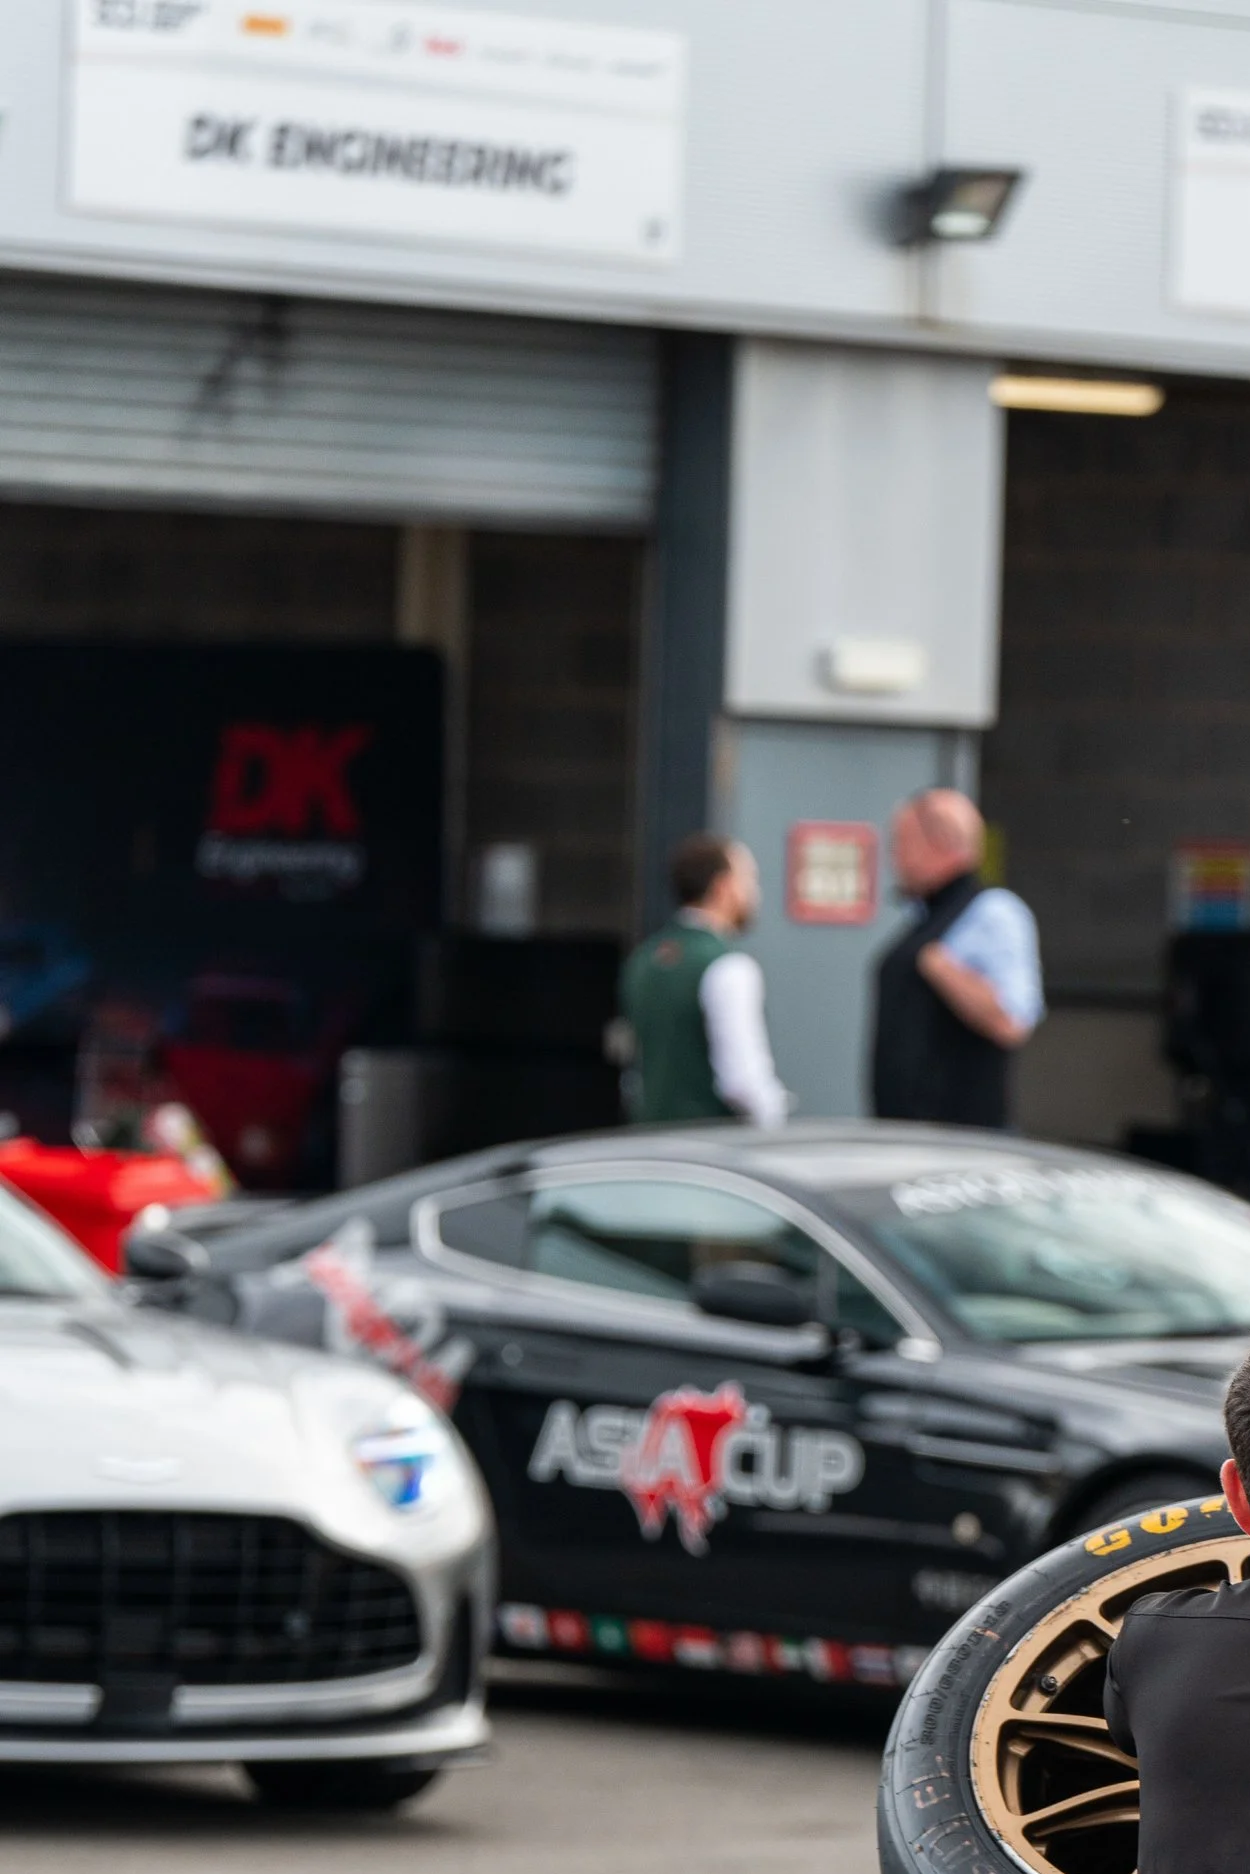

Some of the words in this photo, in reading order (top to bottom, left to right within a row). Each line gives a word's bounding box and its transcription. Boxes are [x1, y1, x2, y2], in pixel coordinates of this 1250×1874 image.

[184, 113, 254, 163] DK
[268, 121, 573, 196] ENGINEERING
[213, 724, 370, 833] DK
[722, 1427, 866, 1513] CUP
